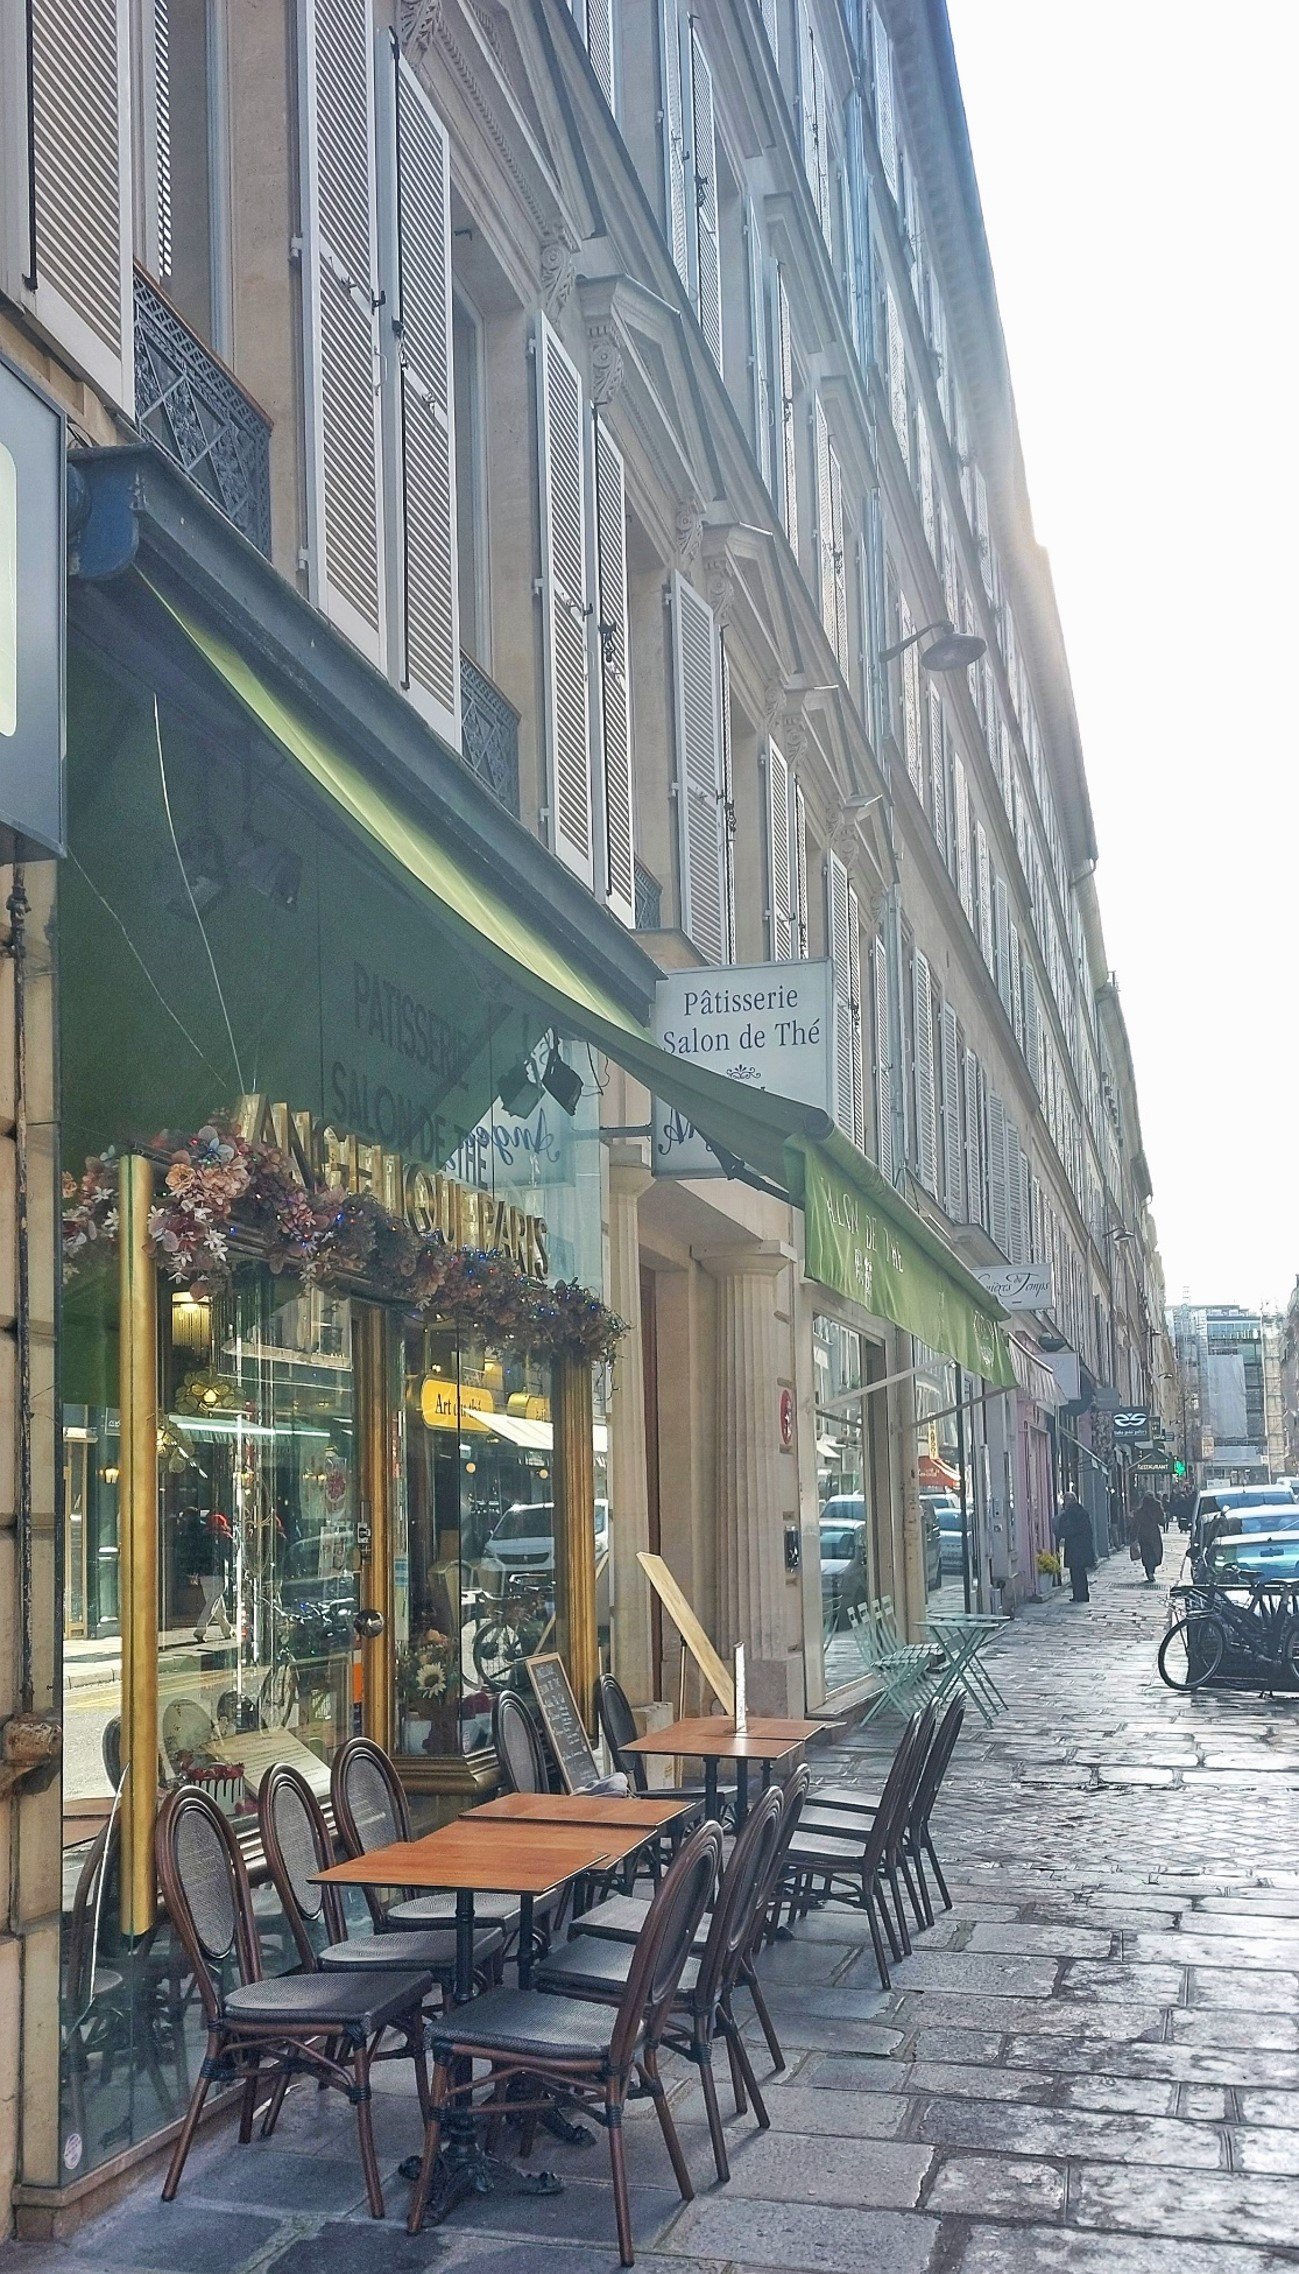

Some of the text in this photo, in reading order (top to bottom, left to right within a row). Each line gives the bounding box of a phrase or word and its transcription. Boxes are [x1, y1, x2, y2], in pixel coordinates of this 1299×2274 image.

[684, 985, 798, 1016] Pâtisserie
[663, 1018, 820, 1054] Salon de Thé
[331, 1061, 414, 1149] SALON
[419, 1105, 446, 1168] DE
[477, 1190, 548, 1281] PARIS
[998, 1272, 1051, 1298] Temps
[435, 1393, 452, 1416] Art
